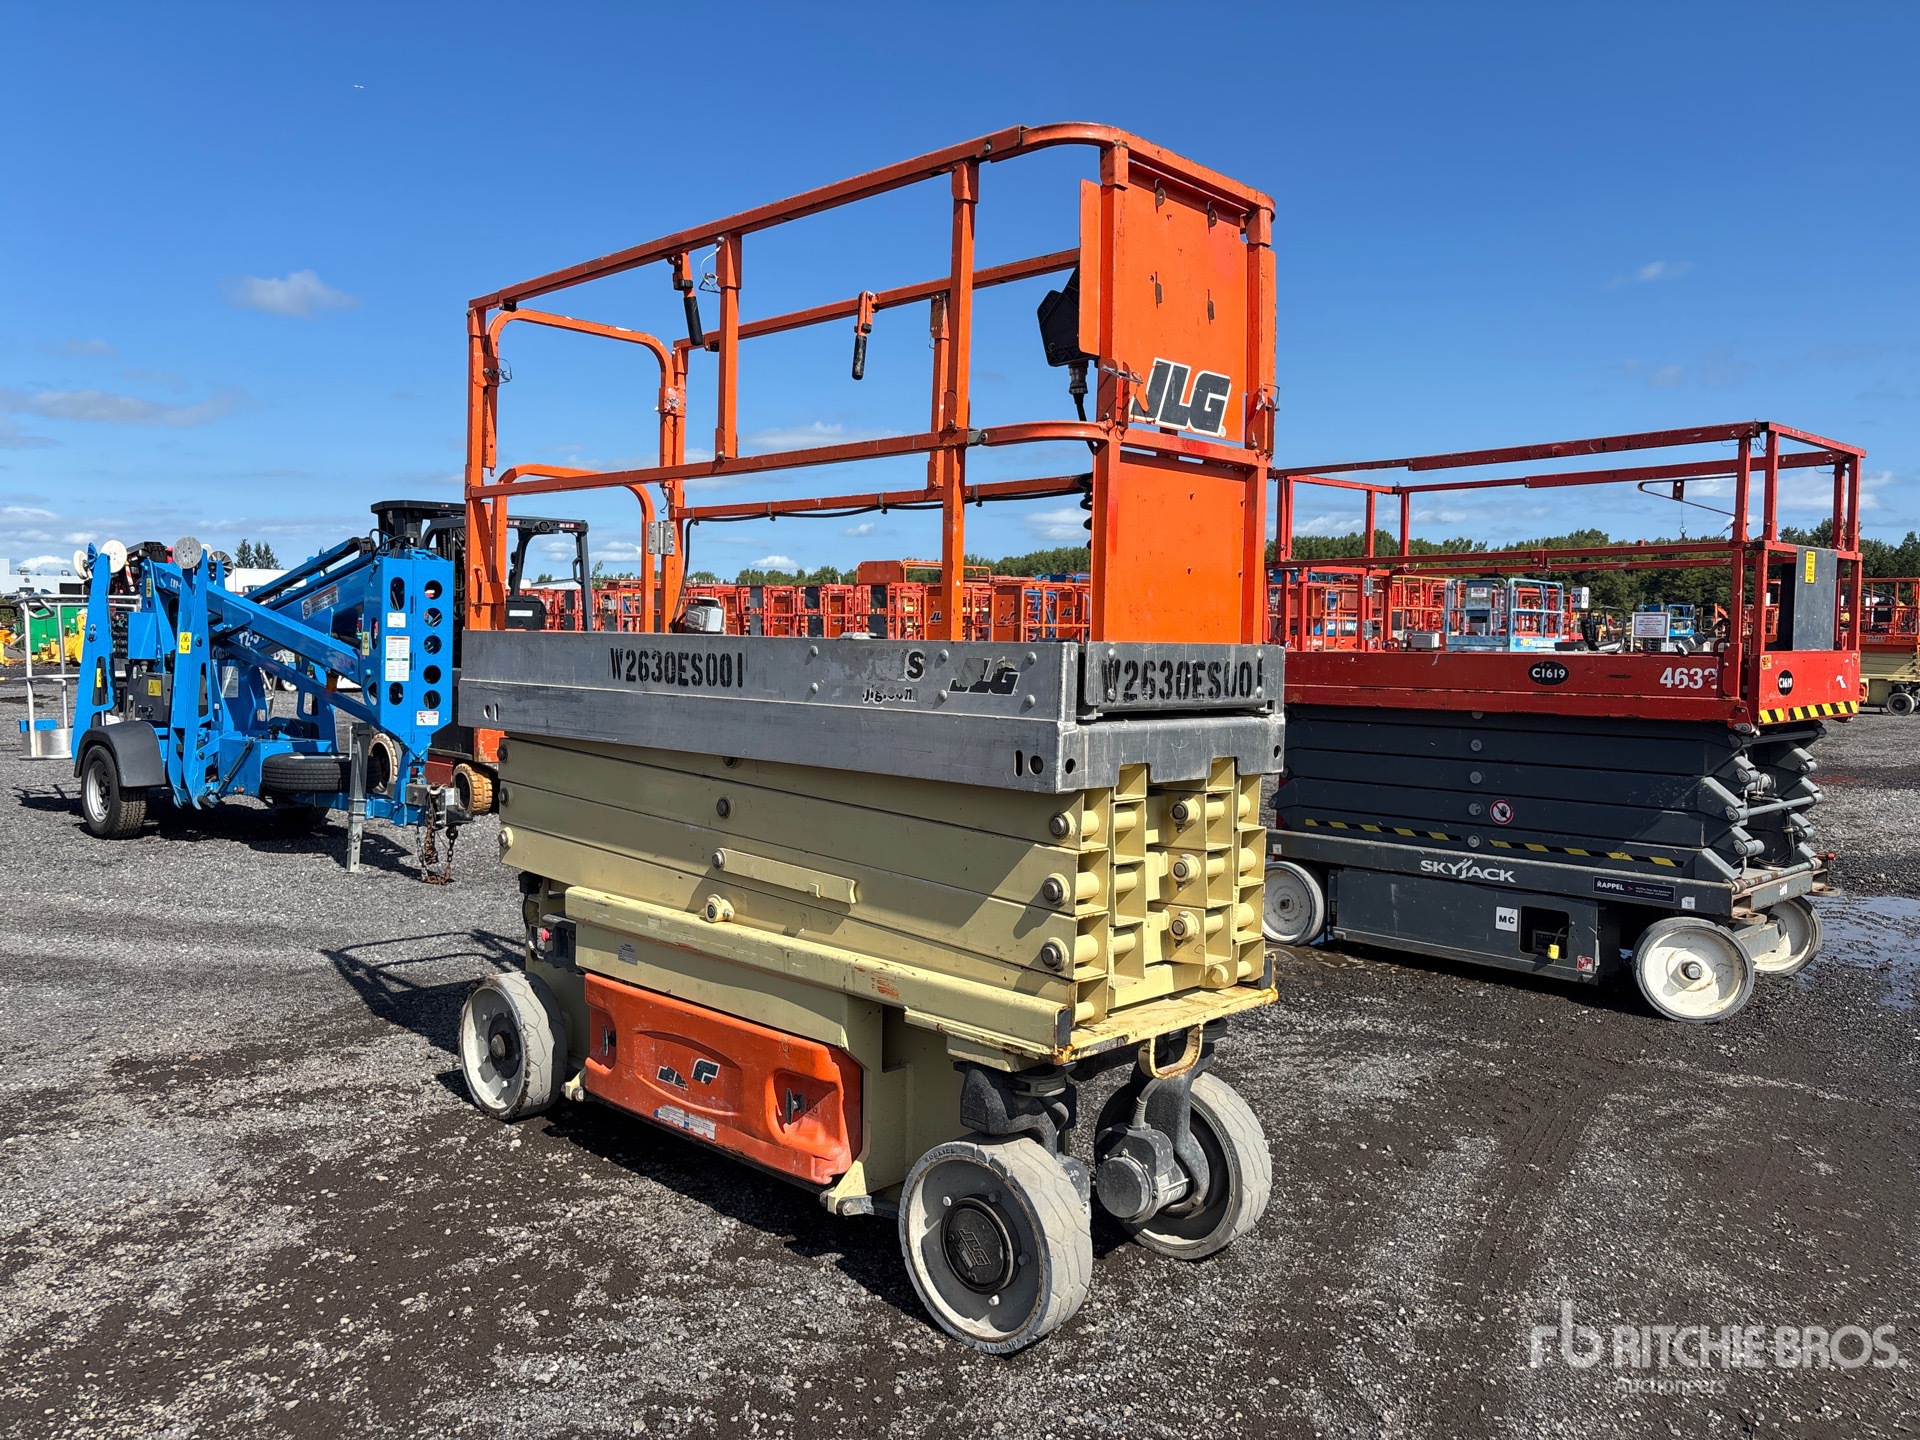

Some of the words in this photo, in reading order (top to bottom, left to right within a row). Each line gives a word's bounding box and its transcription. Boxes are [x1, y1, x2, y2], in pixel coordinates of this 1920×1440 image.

[1129, 357, 1231, 436] JLG
[609, 647, 744, 688] W2630ES001
[1102, 658, 1264, 702] W2630ES001
[1532, 669, 1566, 679] C1619
[1420, 858, 1516, 883] SKYJACK
[1596, 880, 1625, 891] RAPPEL
